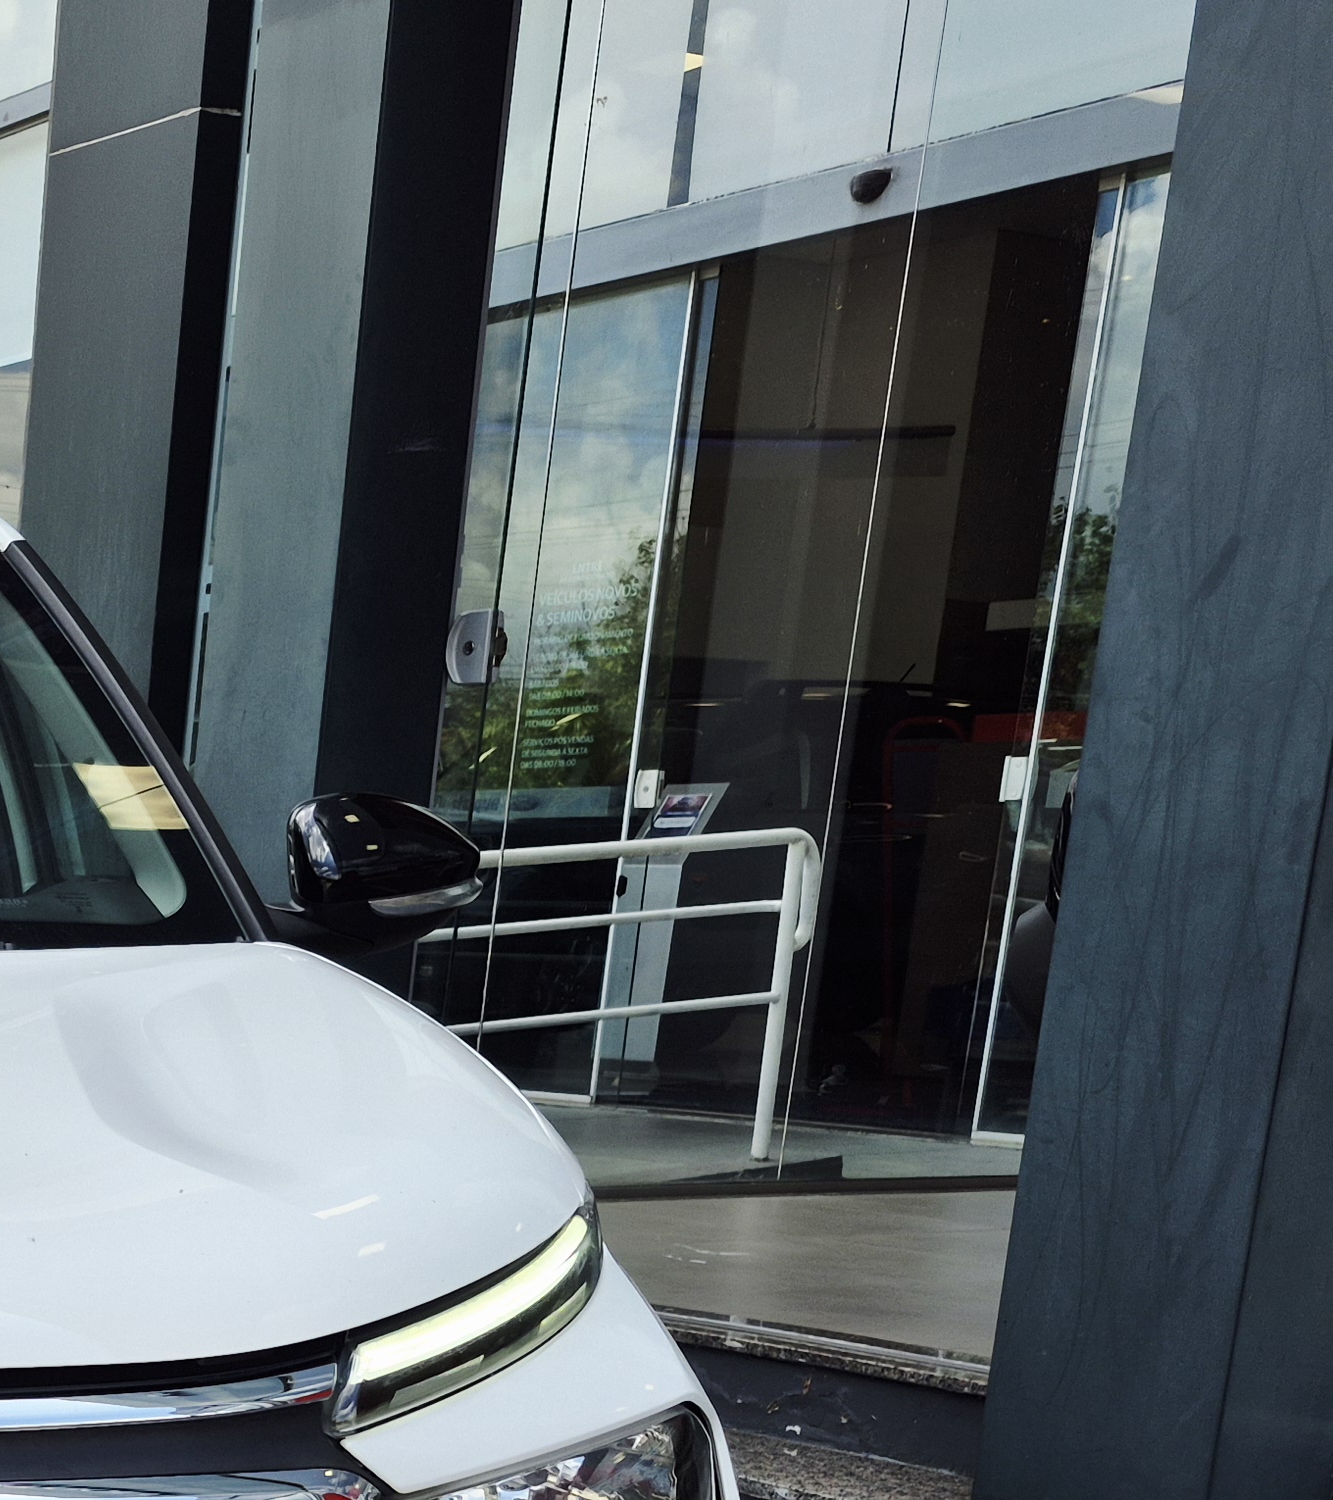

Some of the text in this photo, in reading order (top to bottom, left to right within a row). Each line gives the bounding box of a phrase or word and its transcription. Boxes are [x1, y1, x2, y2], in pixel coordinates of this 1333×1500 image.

[539, 583, 638, 606] VEÍCULOS NOVOS
[536, 606, 615, 626] & SEMINOVOS
